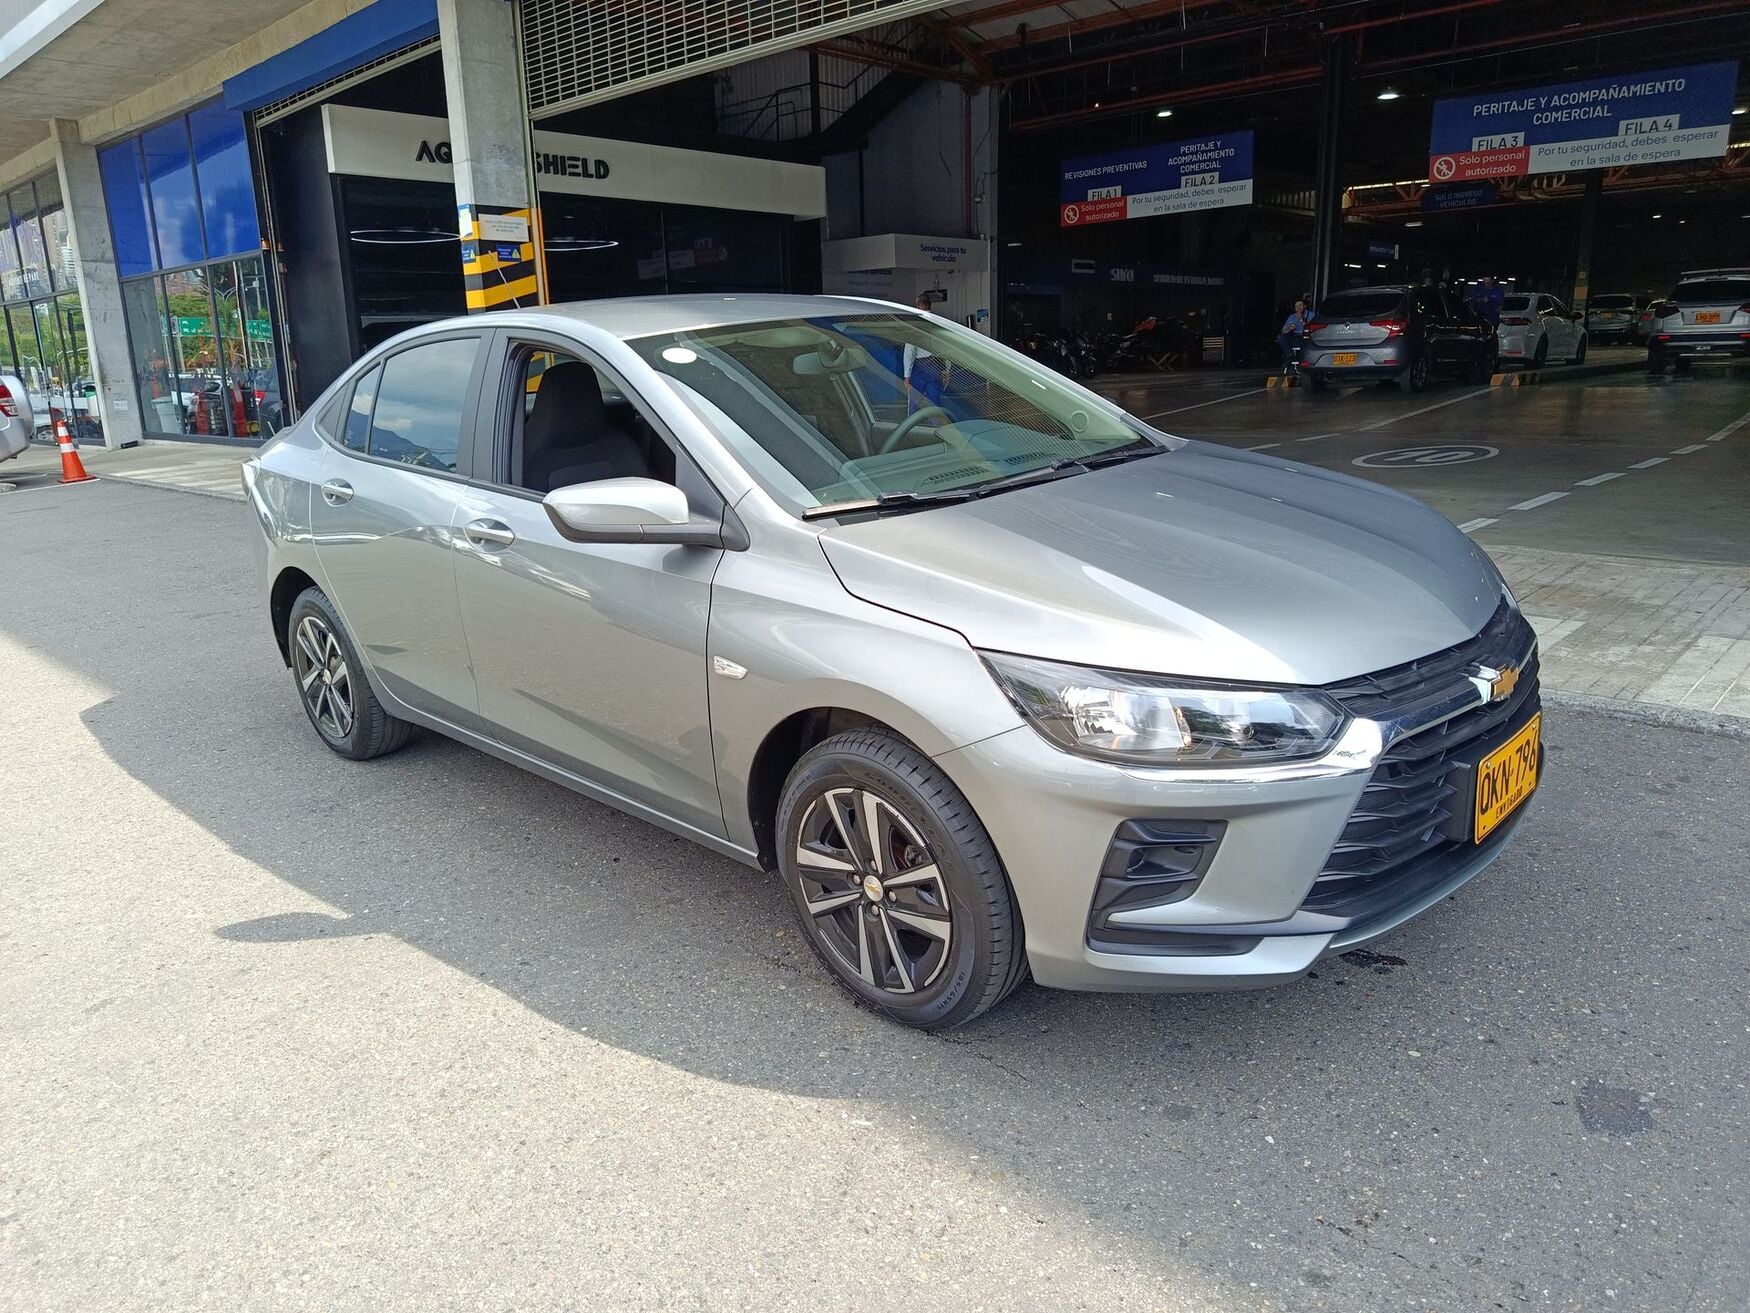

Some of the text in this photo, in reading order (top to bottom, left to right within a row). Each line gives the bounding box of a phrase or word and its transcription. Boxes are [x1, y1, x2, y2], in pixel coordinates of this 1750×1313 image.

[1473, 78, 1686, 117] PERITAJE Y ACOMPAÑAMIENTO
[1533, 105, 1613, 125] COMERCIAL
[1625, 119, 1673, 136] FILA 4
[1180, 140, 1222, 154] PERITAJE Y
[1477, 137, 1519, 151] FILA 3
[1538, 130, 1719, 157] Por tu seguridad, debes esperar
[1168, 148, 1235, 166] ACOMPAÑAMIENTO
[1459, 150, 1525, 165] Solo personal
[1570, 148, 1681, 168] en la sala de espera
[1064, 160, 1148, 180] REVISIONES PREVENTIVAS
[1180, 161, 1222, 174] COMERCIAL
[1465, 163, 1516, 177] autorizado
[1184, 176, 1215, 188] FILA 2
[1092, 188, 1118, 200] FILA 1
[1132, 196, 1144, 205] Por
[1144, 195, 1152, 203] tu
[1191, 187, 1215, 197] debes
[1218, 184, 1247, 196] esperar
[1081, 200, 1124, 212] Solo personal
[1164, 204, 1171, 212] la
[1171, 202, 1186, 211] sala
[1187, 200, 1198, 209] de
[1199, 198, 1224, 209] espera
[1085, 210, 1119, 221] autorizado
[920, 243, 946, 253] Servicios
[946, 247, 959, 255] para
